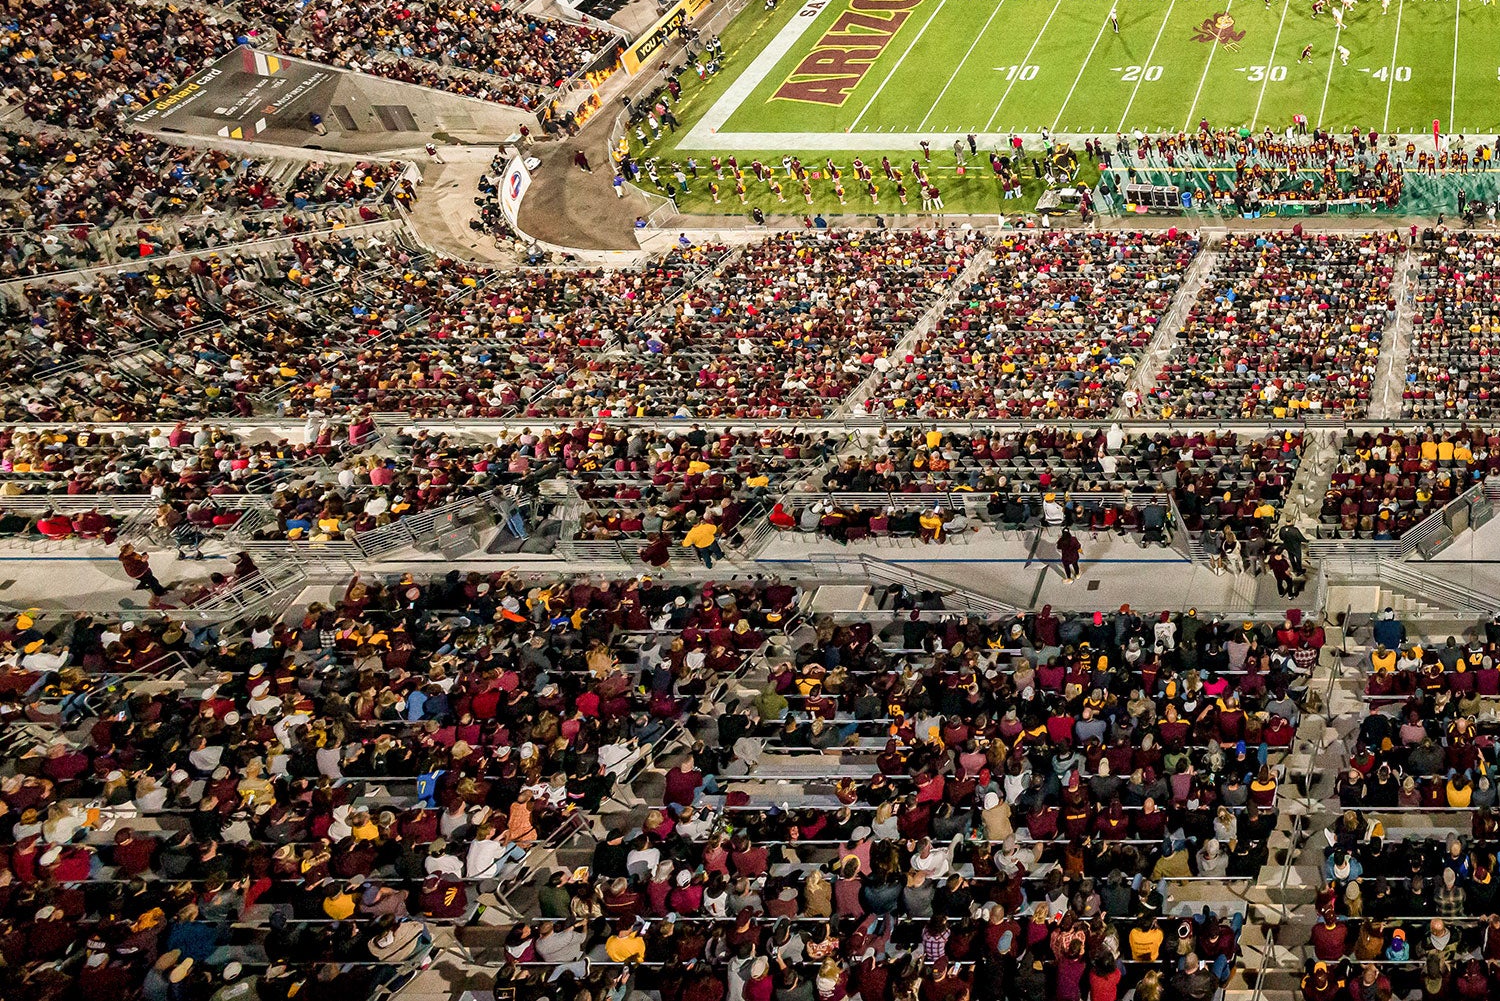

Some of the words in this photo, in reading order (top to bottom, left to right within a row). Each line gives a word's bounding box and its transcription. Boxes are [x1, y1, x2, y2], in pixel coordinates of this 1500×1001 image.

[640, 38, 656, 56] YOU
[1004, 65, 1040, 81] 10
[1121, 66, 1164, 82] 20
[1246, 66, 1288, 82] 30
[1372, 66, 1412, 82] 40
[133, 107, 160, 123] the
[156, 82, 200, 112] diehard
